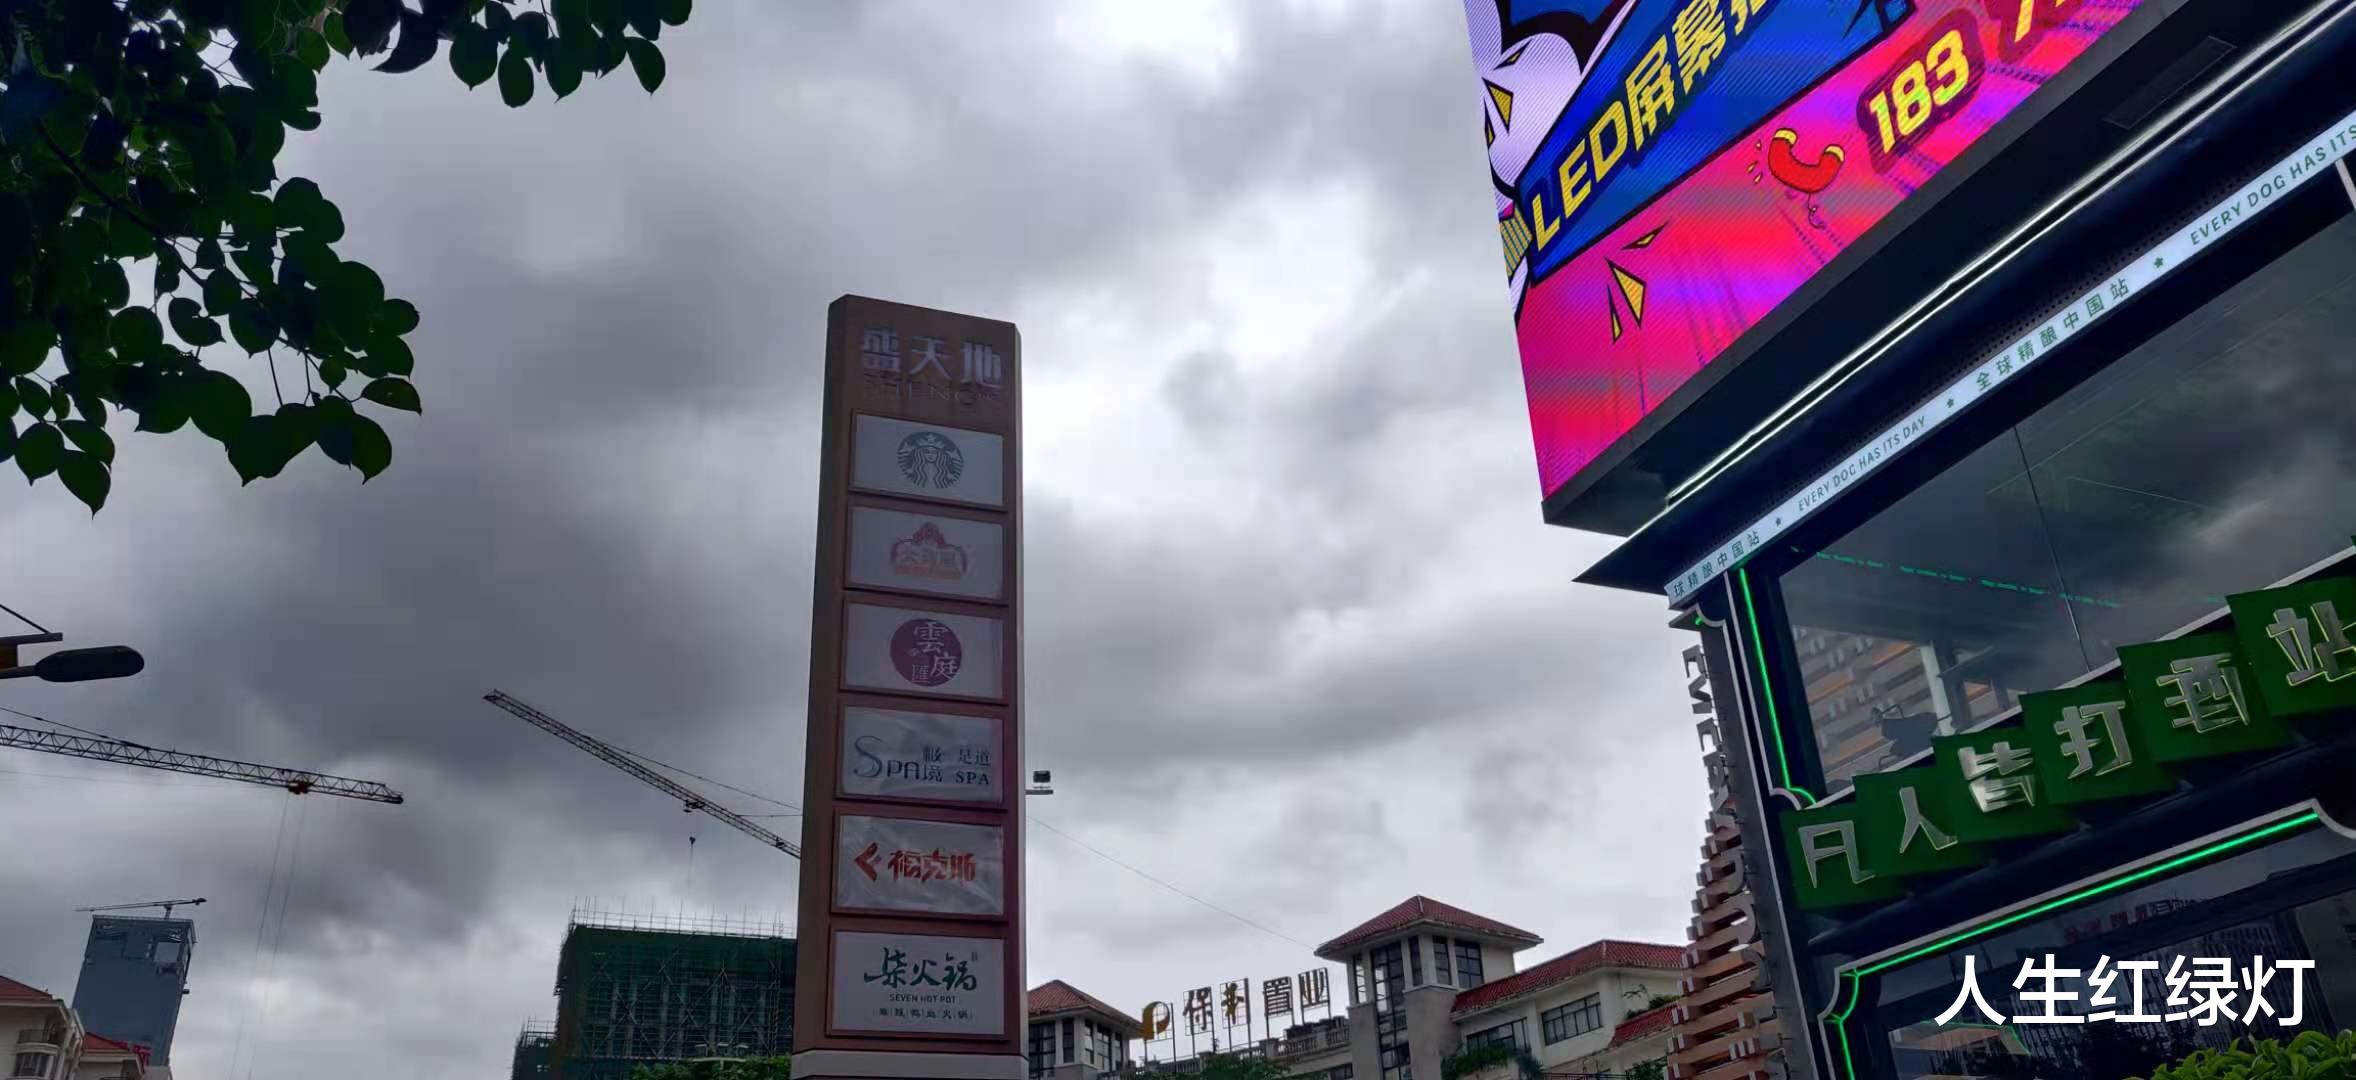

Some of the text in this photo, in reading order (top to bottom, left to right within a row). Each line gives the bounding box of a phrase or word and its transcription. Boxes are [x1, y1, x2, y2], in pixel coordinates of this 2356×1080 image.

[1869, 29, 1969, 154] 183
[2190, 202, 2242, 245] EVERY
[2247, 175, 2286, 207] DOG
[2289, 147, 2326, 179] HAS
[1975, 278, 2130, 392] 全球精酿中国站
[1797, 415, 1926, 512] EVERY DOG HAS ITS DAY
[955, 770, 989, 785] SPA
